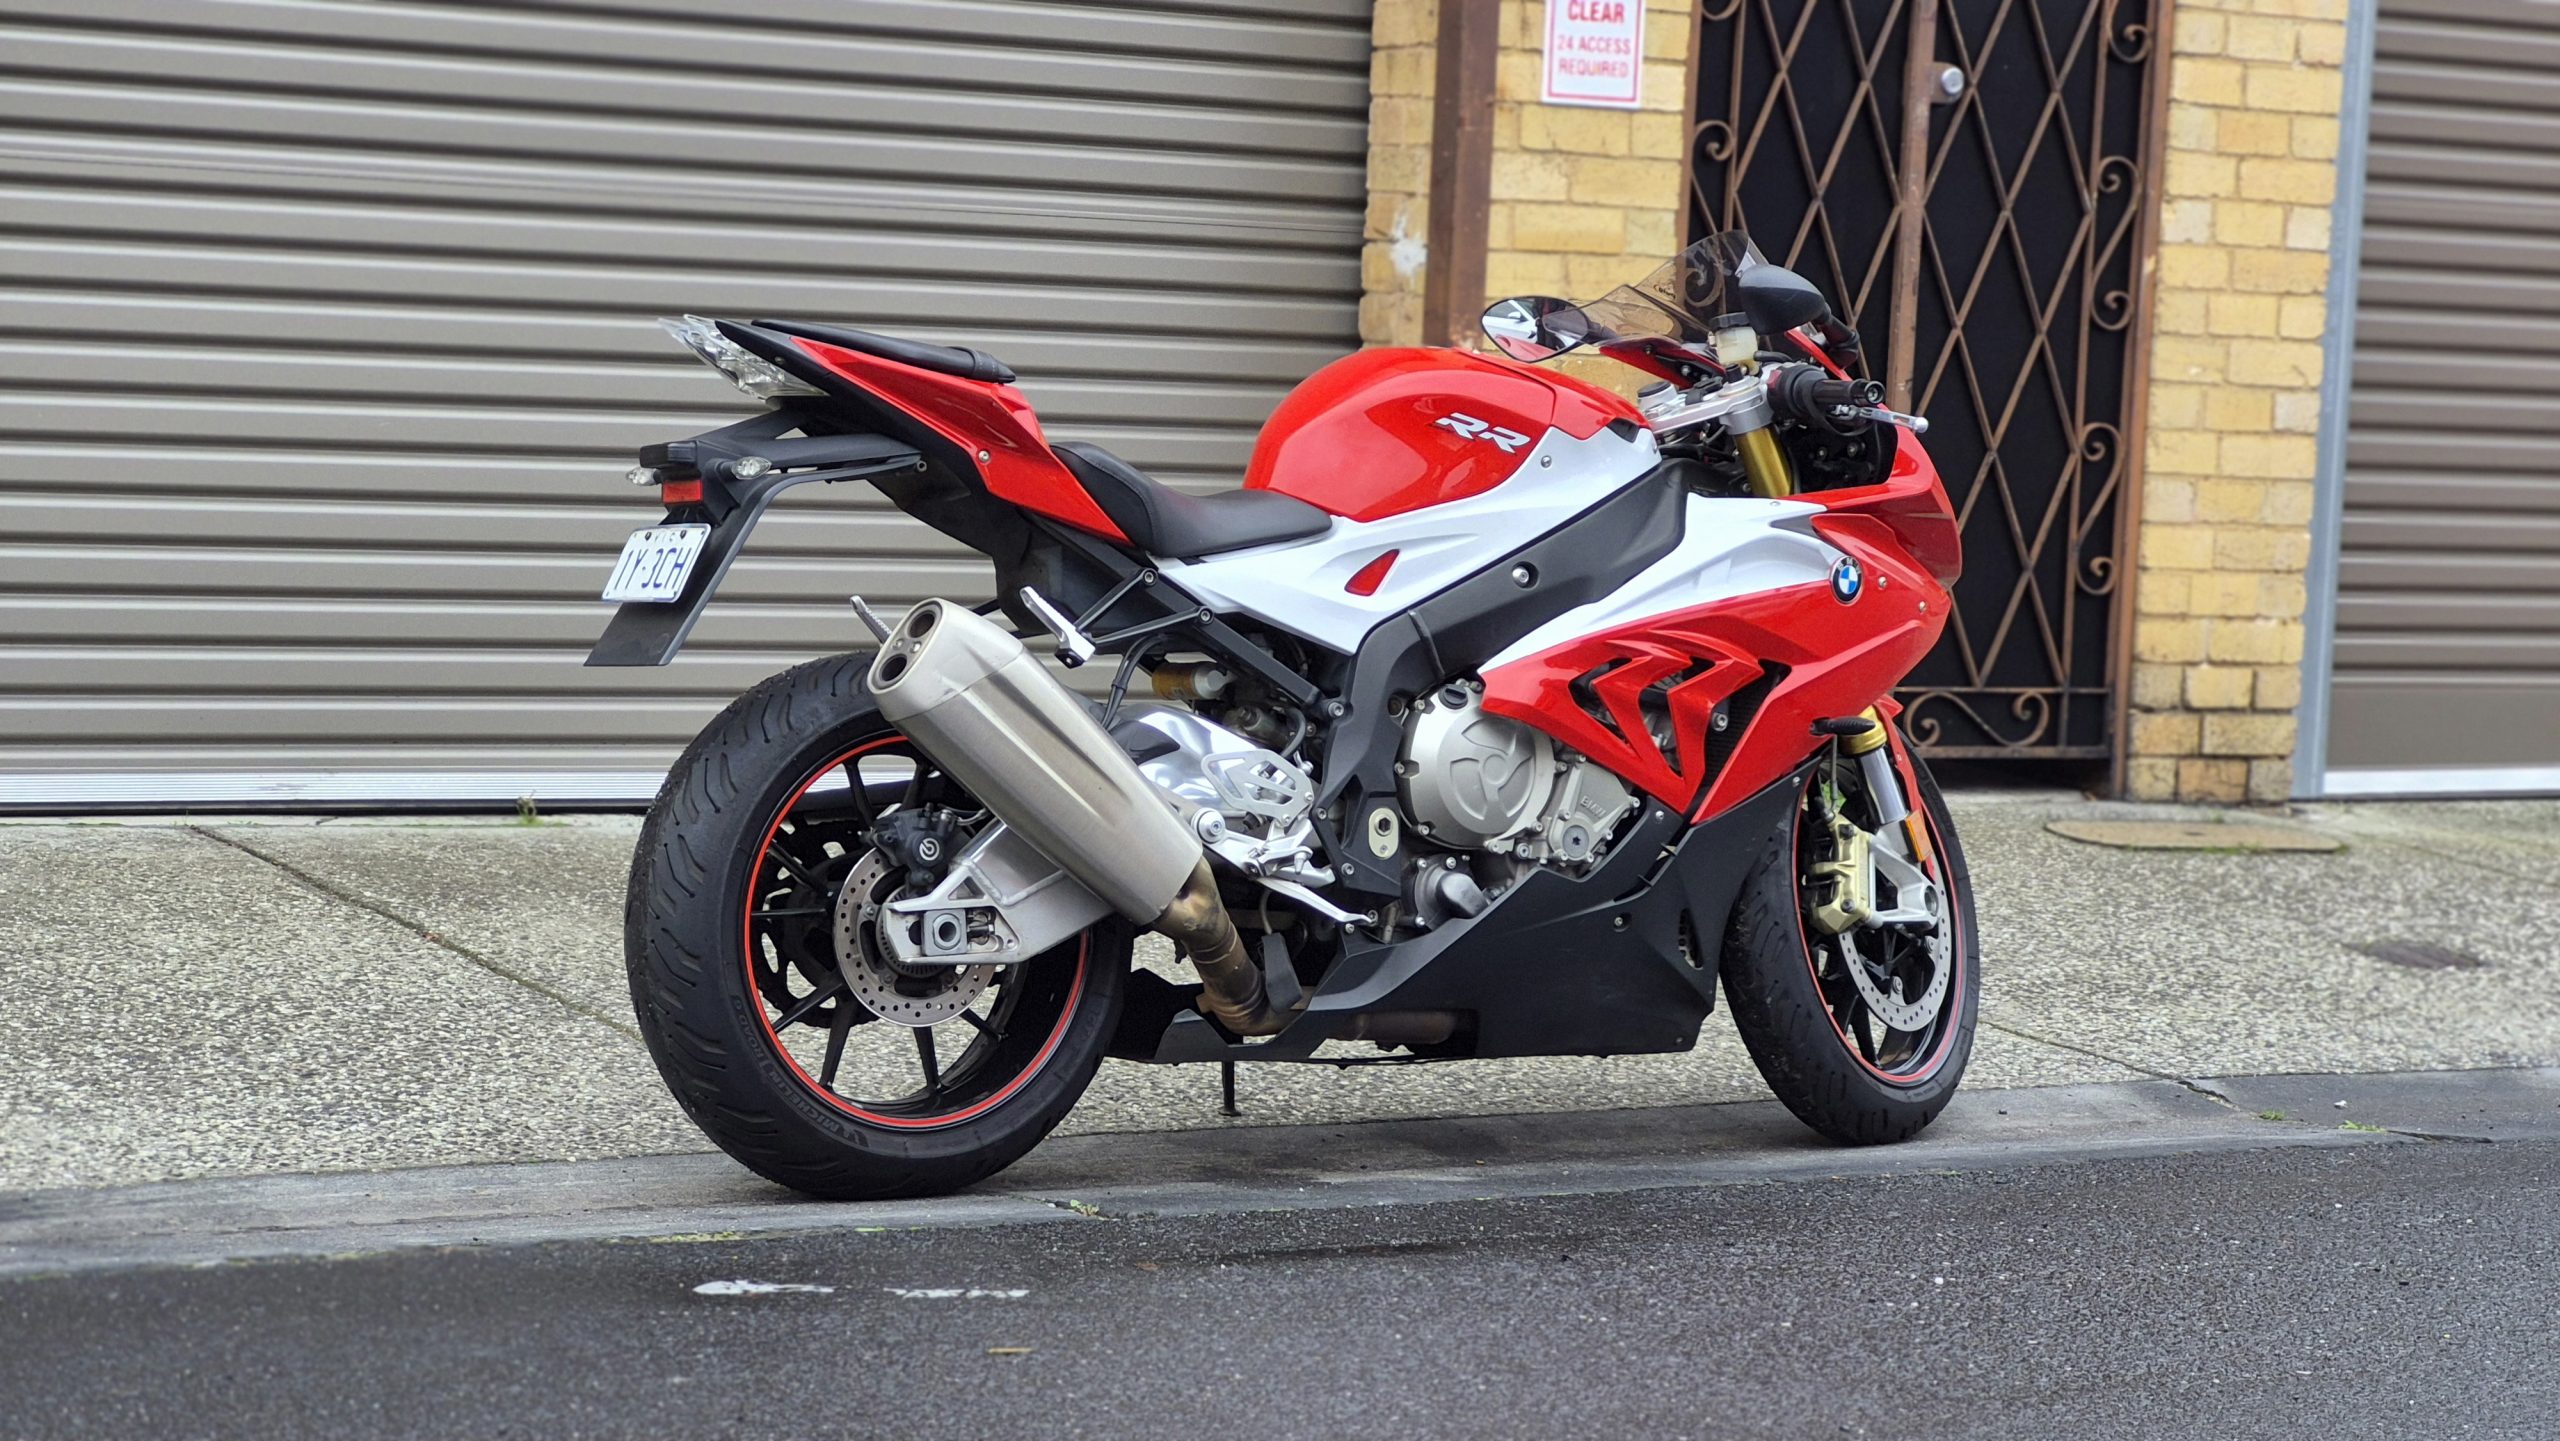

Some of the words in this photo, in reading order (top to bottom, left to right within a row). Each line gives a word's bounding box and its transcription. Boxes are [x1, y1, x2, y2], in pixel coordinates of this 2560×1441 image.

[1568, 0, 1625, 23] CLEAR
[1557, 35, 1573, 50] 24
[1579, 36, 1631, 55] ACCESS
[1559, 58, 1629, 78] REQUIRED
[1435, 412, 1531, 454] RR
[1837, 557, 1862, 574] BMW
[1580, 795, 1607, 818] BMW
[737, 1014, 764, 1060] ROAD
[767, 1069, 841, 1132] MICHELIN
